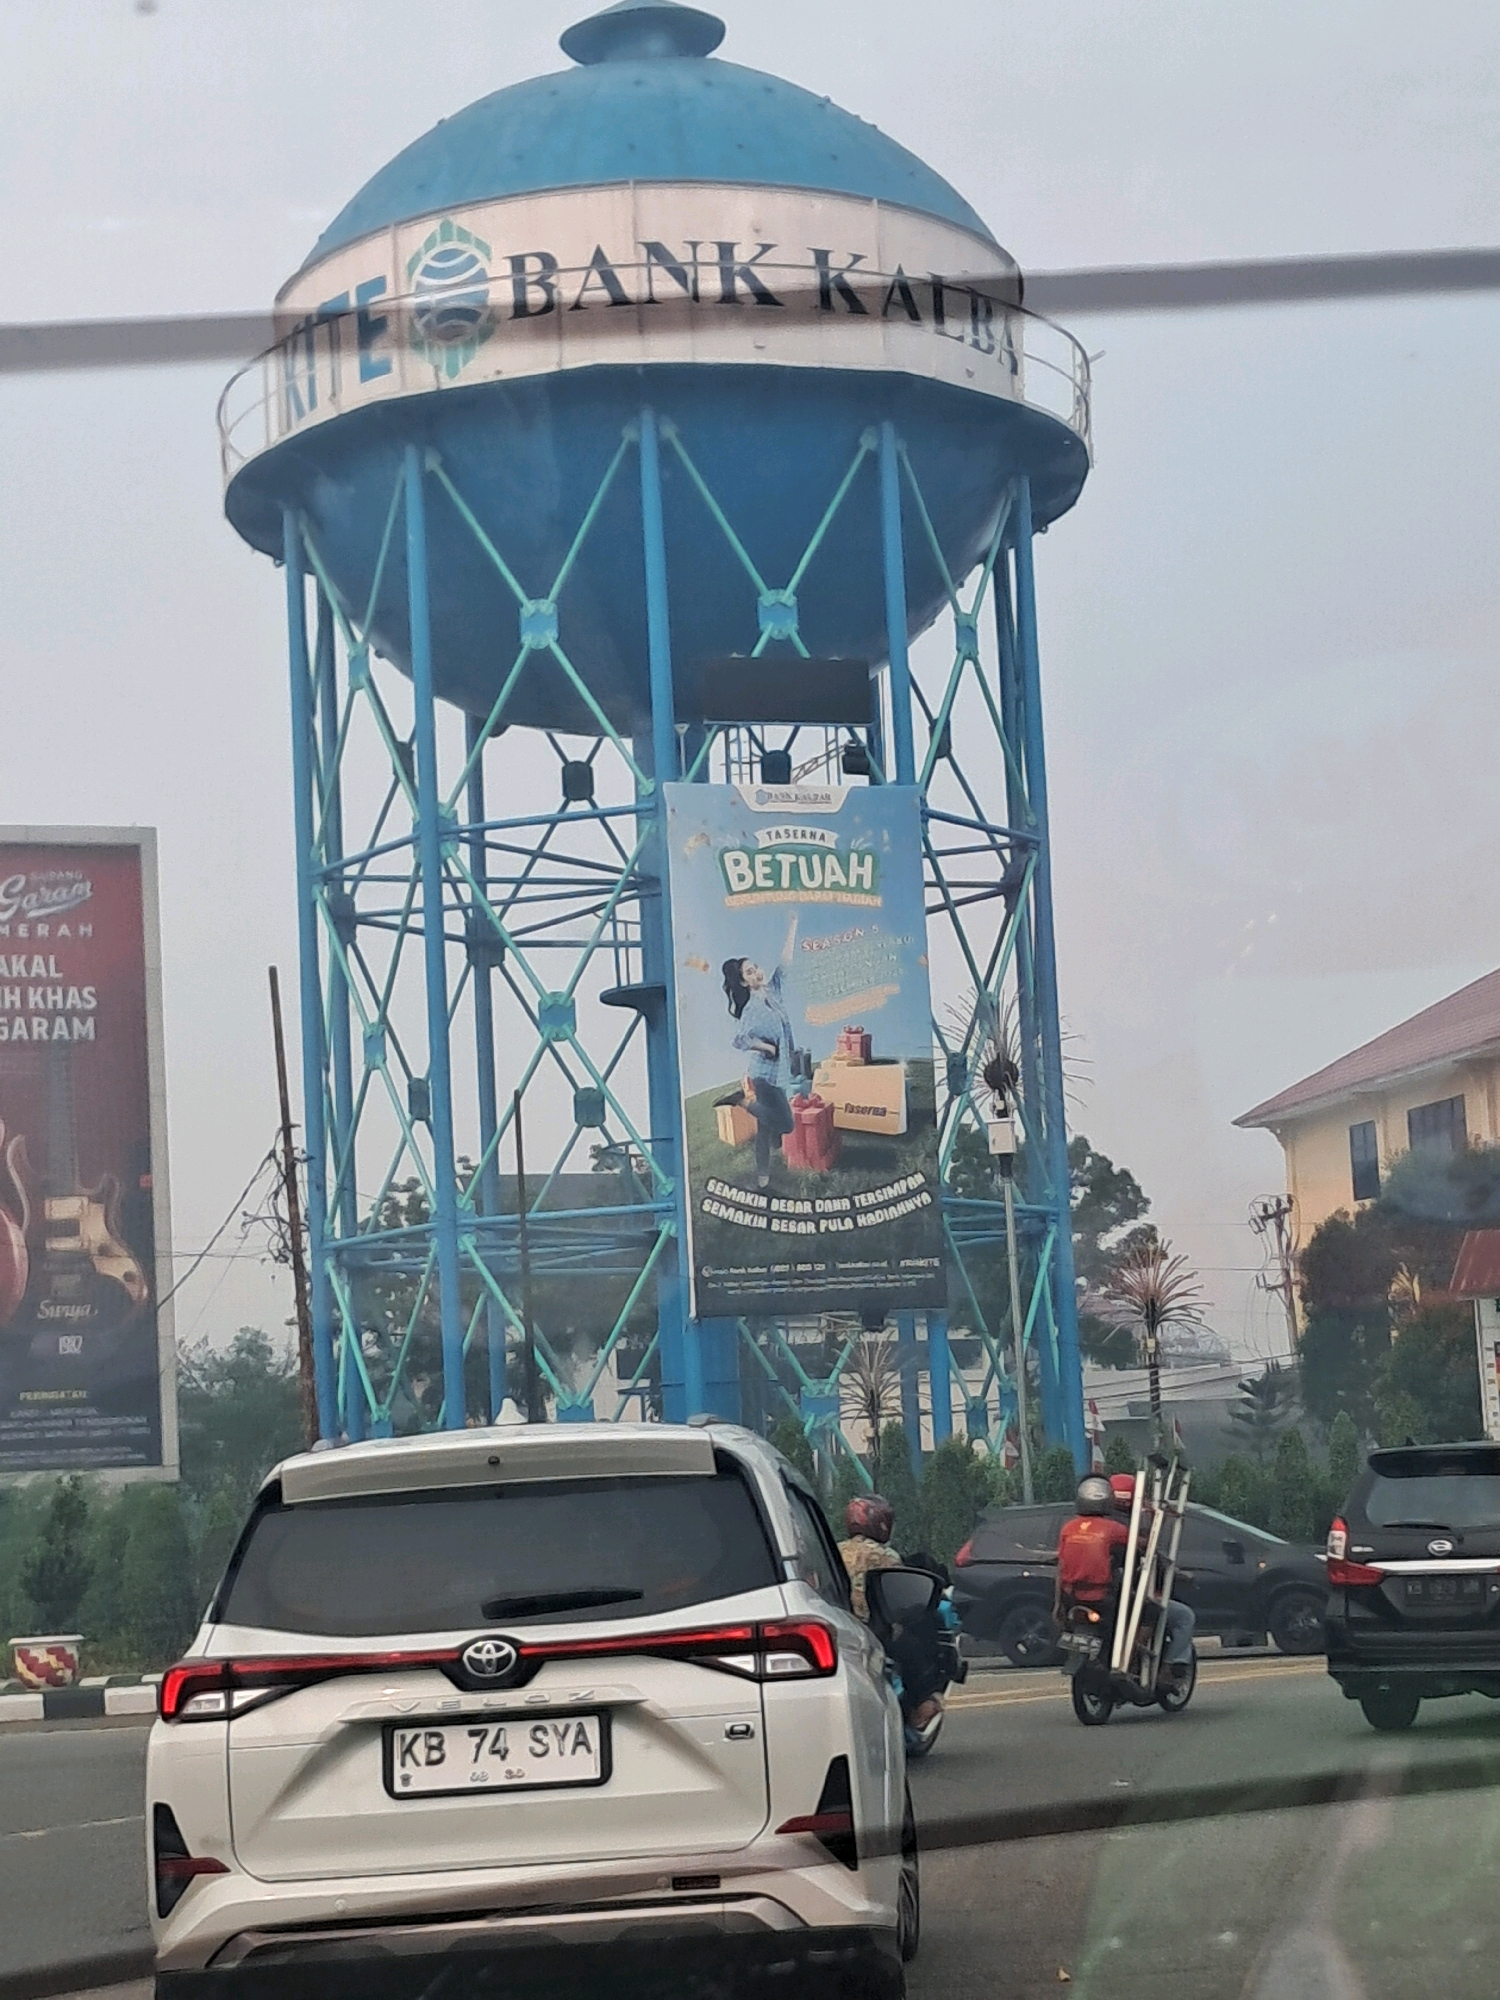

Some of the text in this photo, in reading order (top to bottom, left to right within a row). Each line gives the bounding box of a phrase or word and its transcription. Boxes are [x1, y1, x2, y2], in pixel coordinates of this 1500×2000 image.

[502, 240, 785, 320] BANK
[766, 828, 826, 843] TASERNA
[723, 850, 873, 892] BETUAH
[28, 985, 98, 1010] KHAS
[702, 1190, 933, 1234] SEMAKIN BESAR PULA HADIAHNYA
[706, 1171, 926, 1214] SEMAKIN BESAR DANA TERSIMPAN
[391, 1690, 595, 1713] VELOZ
[400, 1721, 592, 1768] KB 74 SYA
